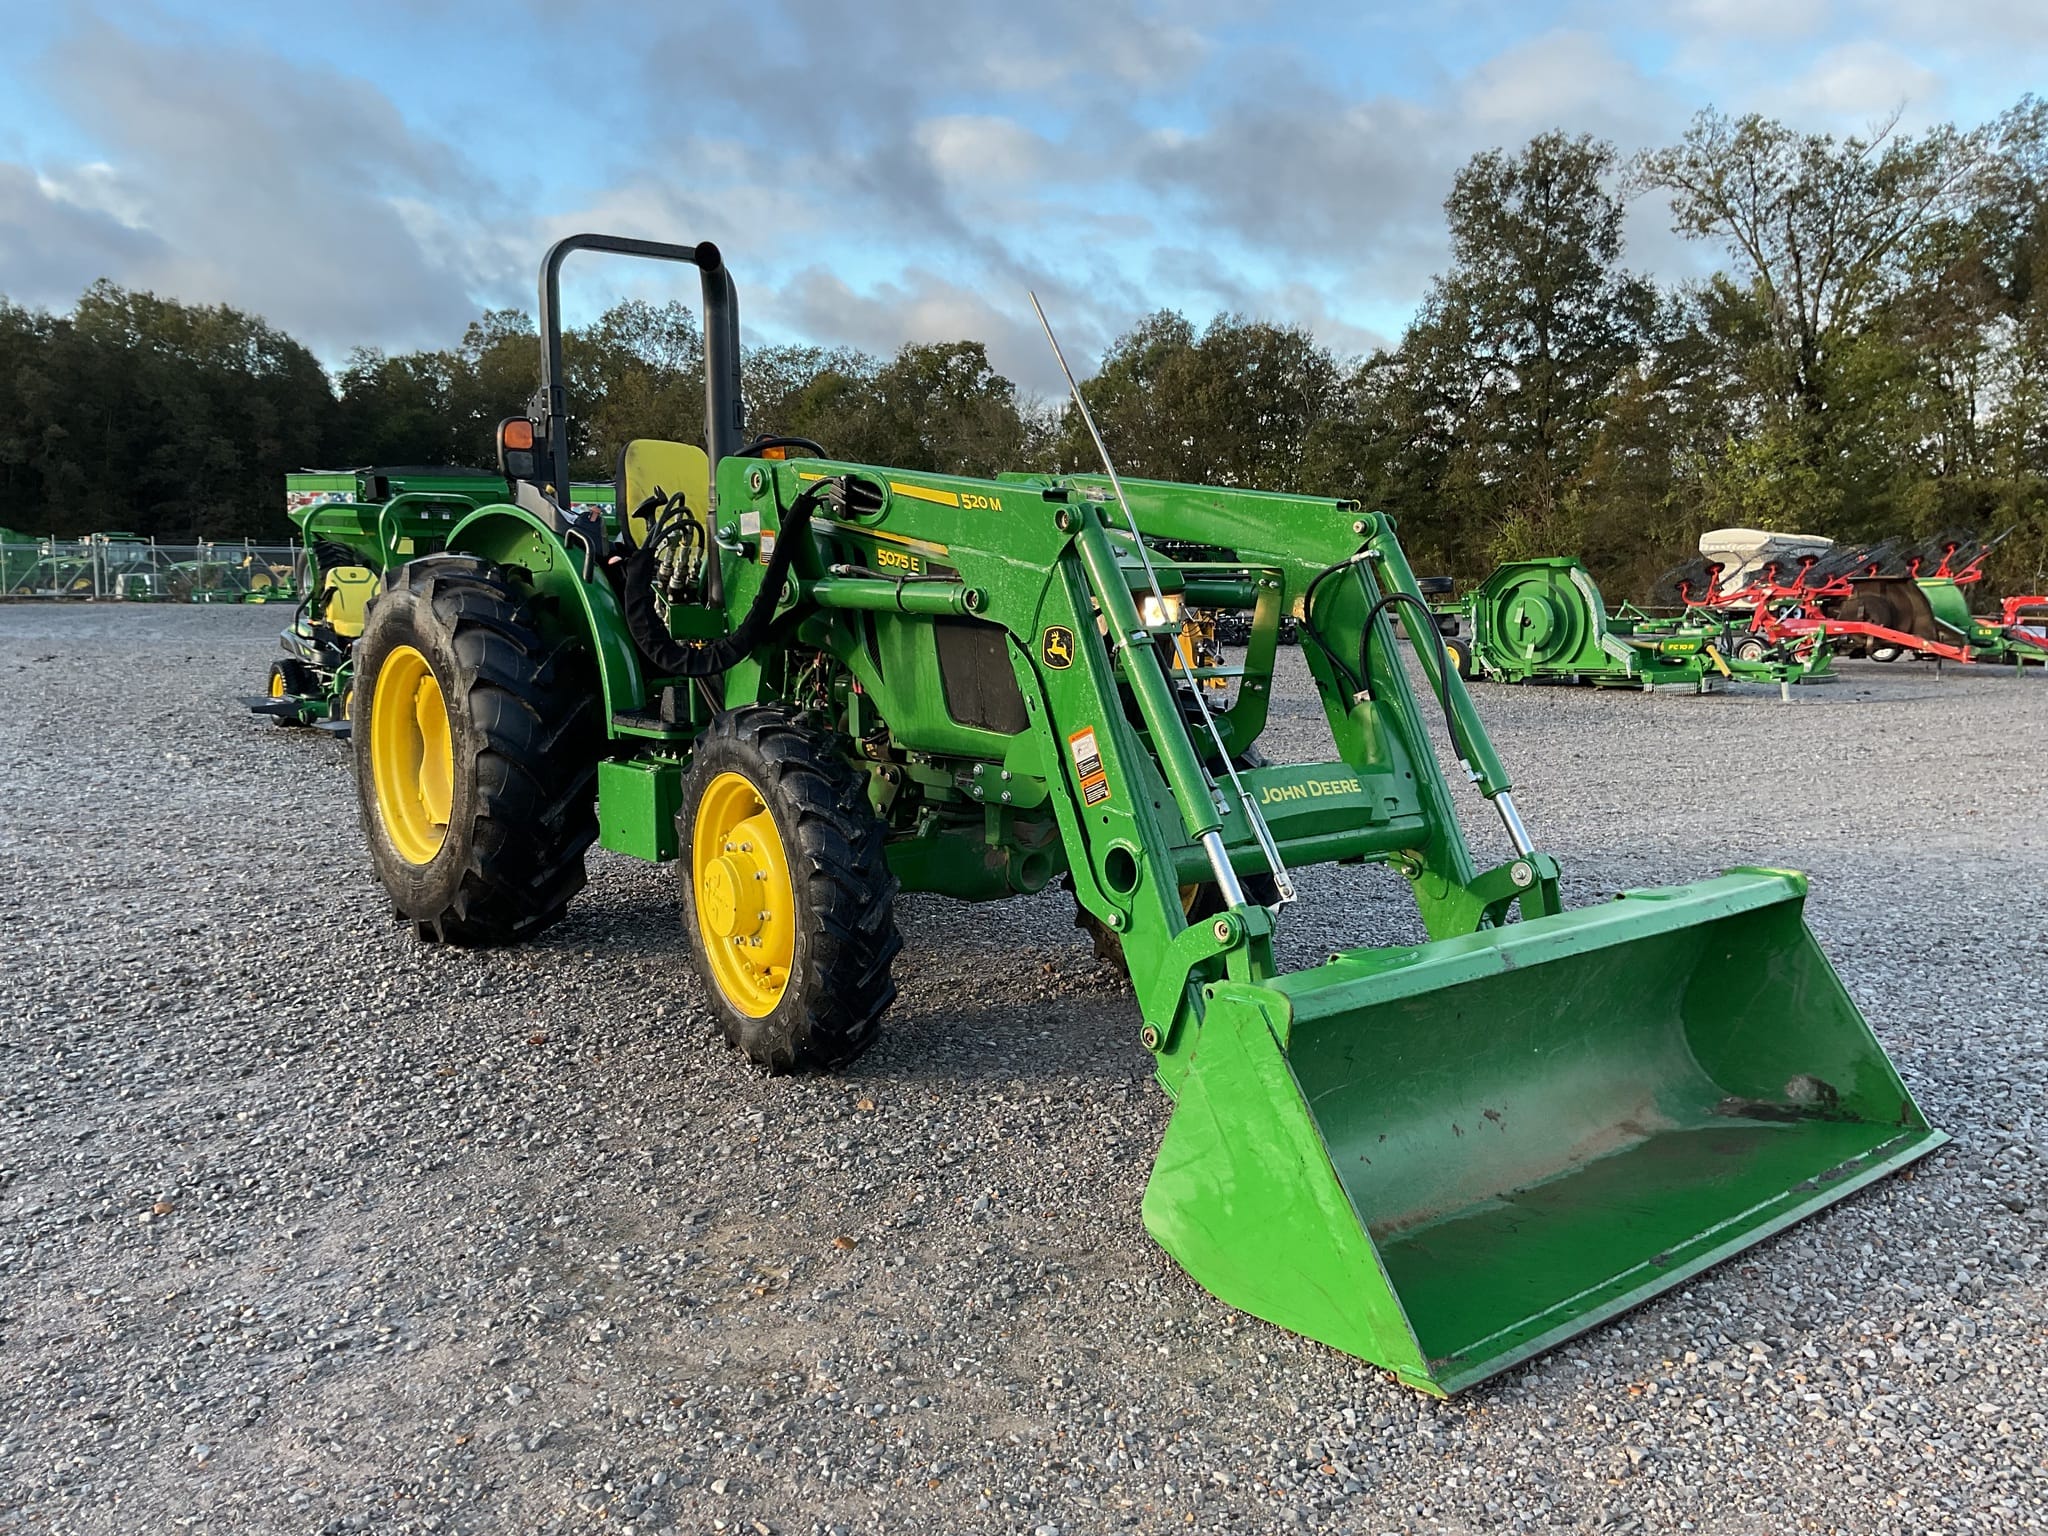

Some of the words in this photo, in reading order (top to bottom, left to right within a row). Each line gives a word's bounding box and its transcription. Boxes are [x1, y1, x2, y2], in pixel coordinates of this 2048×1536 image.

[960, 493, 988, 510] 520
[989, 497, 1003, 512] M
[877, 548, 909, 570] 5075
[910, 556, 920, 572] E
[1261, 784, 1308, 804] JOHN
[1307, 779, 1362, 797] DEERE
